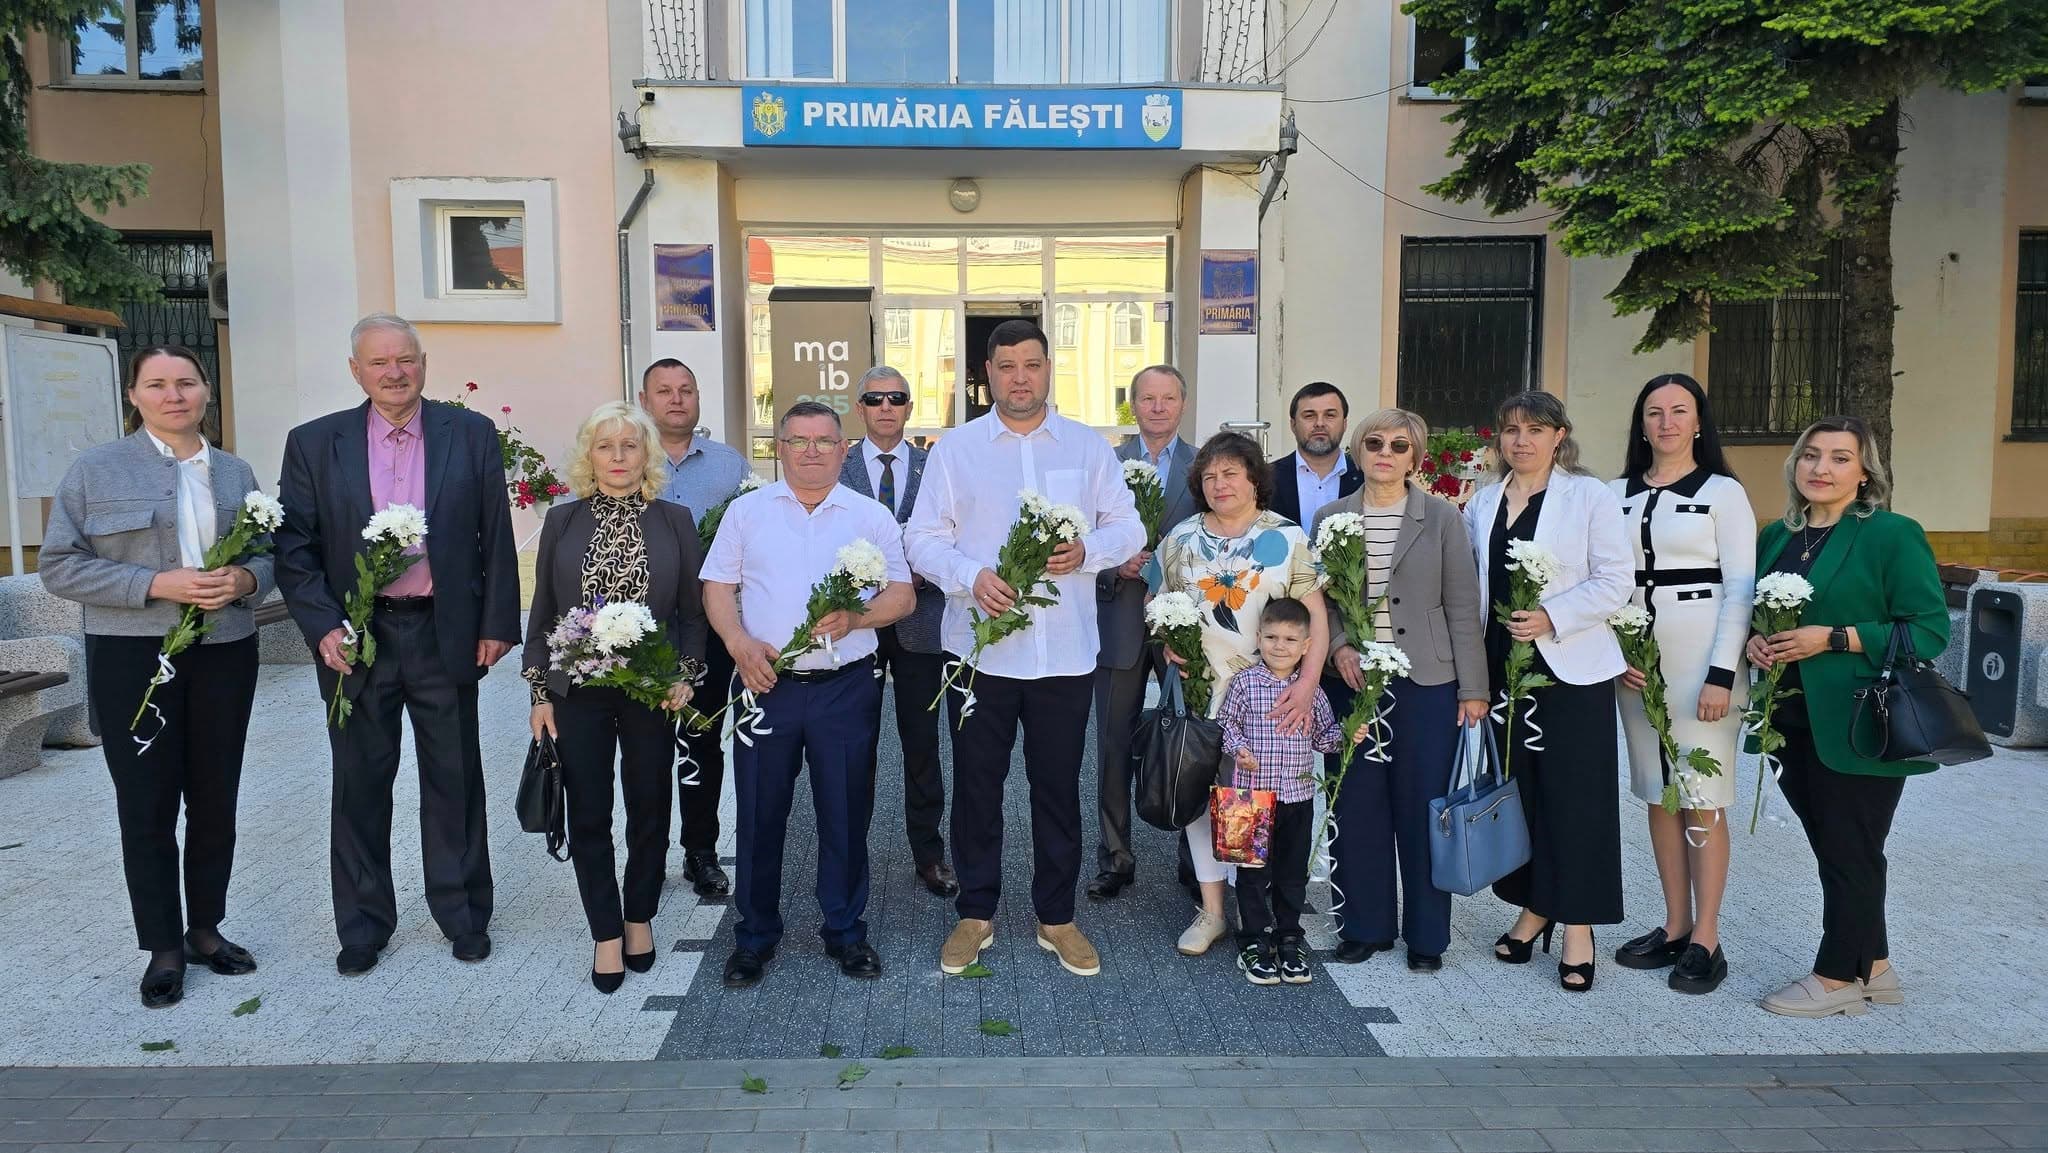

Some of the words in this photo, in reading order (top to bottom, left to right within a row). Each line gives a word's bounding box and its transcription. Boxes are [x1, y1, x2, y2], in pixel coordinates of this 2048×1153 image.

[804, 97, 973, 128] PRIMĂRIA
[984, 98, 1123, 137] FĂLEȘTI
[794, 341, 849, 361] ma
[818, 363, 850, 390] ib
